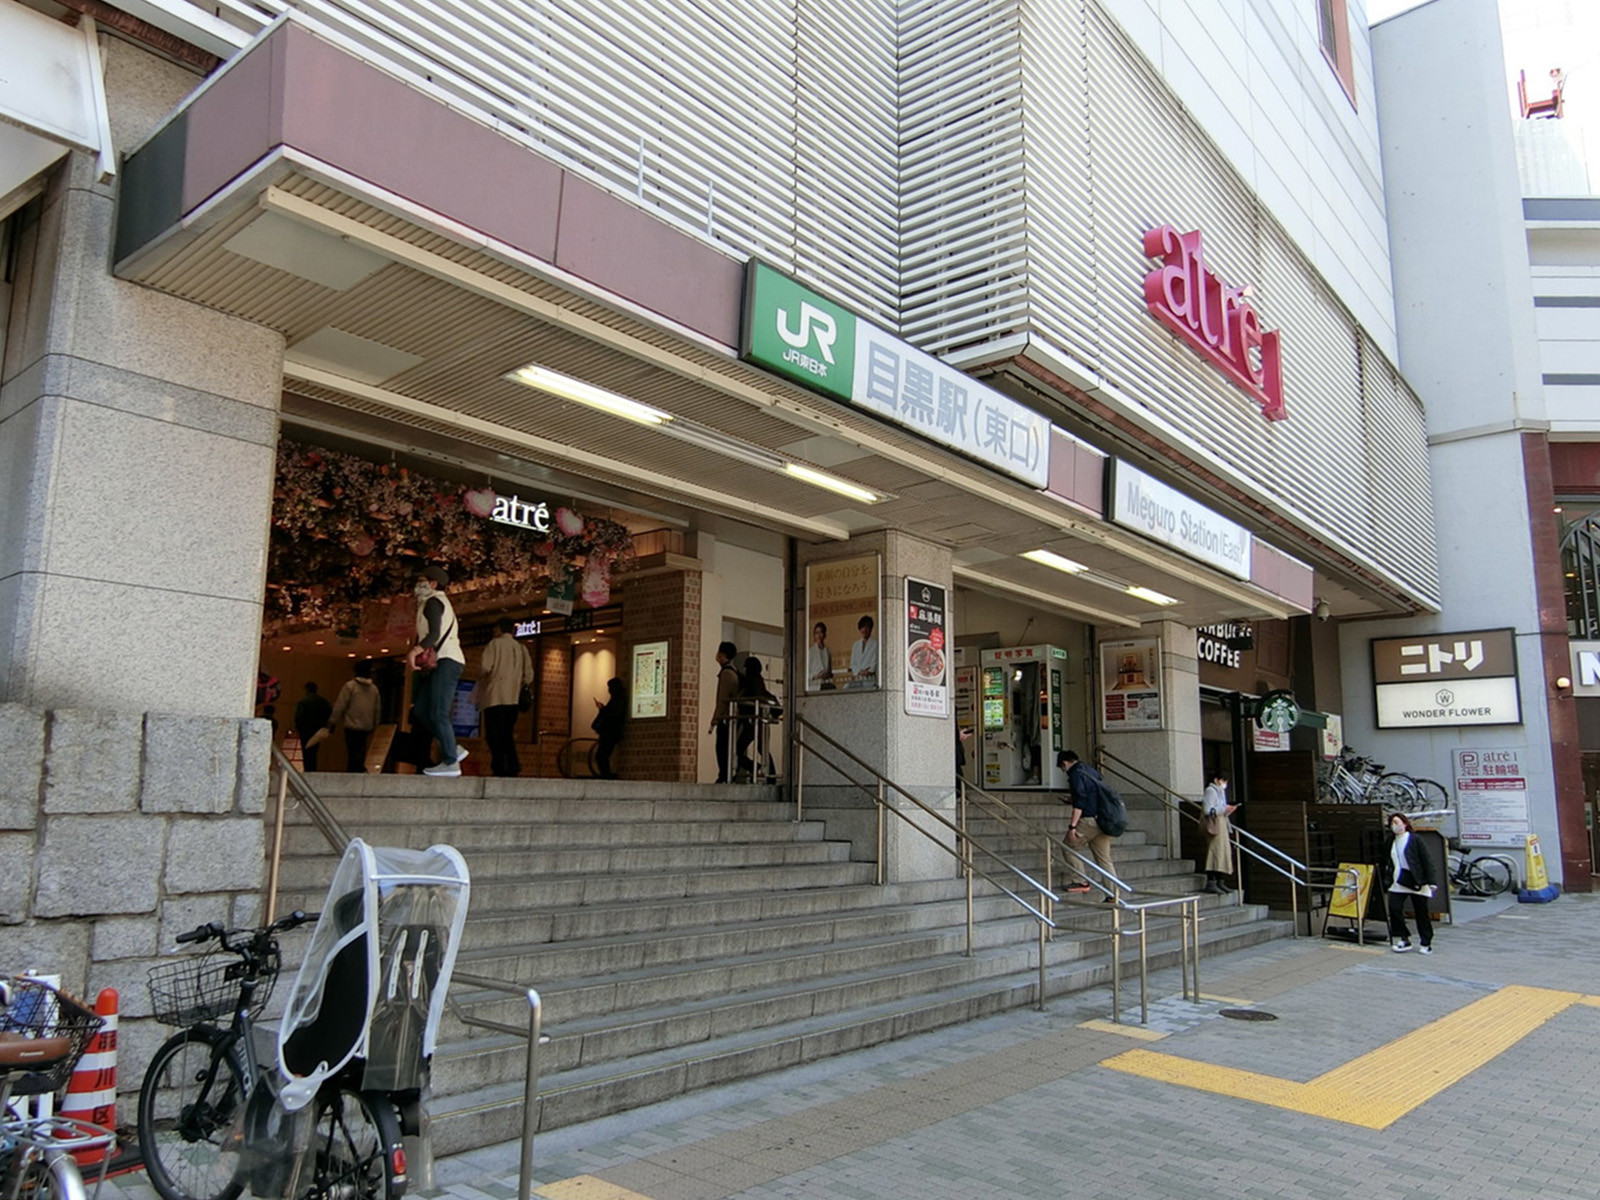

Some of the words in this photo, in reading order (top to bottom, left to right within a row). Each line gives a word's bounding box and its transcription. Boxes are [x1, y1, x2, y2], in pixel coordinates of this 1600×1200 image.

[777, 301, 835, 365] JR
[782, 349, 829, 377] JR東日本
[492, 495, 549, 530] atré
[1127, 481, 1176, 533] Meguro
[1197, 637, 1240, 669] COFFEE
[1401, 640, 1484, 674] ニトリ
[1403, 708, 1446, 719] WONDER
[1449, 707, 1491, 718] FLOWER
[1483, 751, 1510, 762] atré
